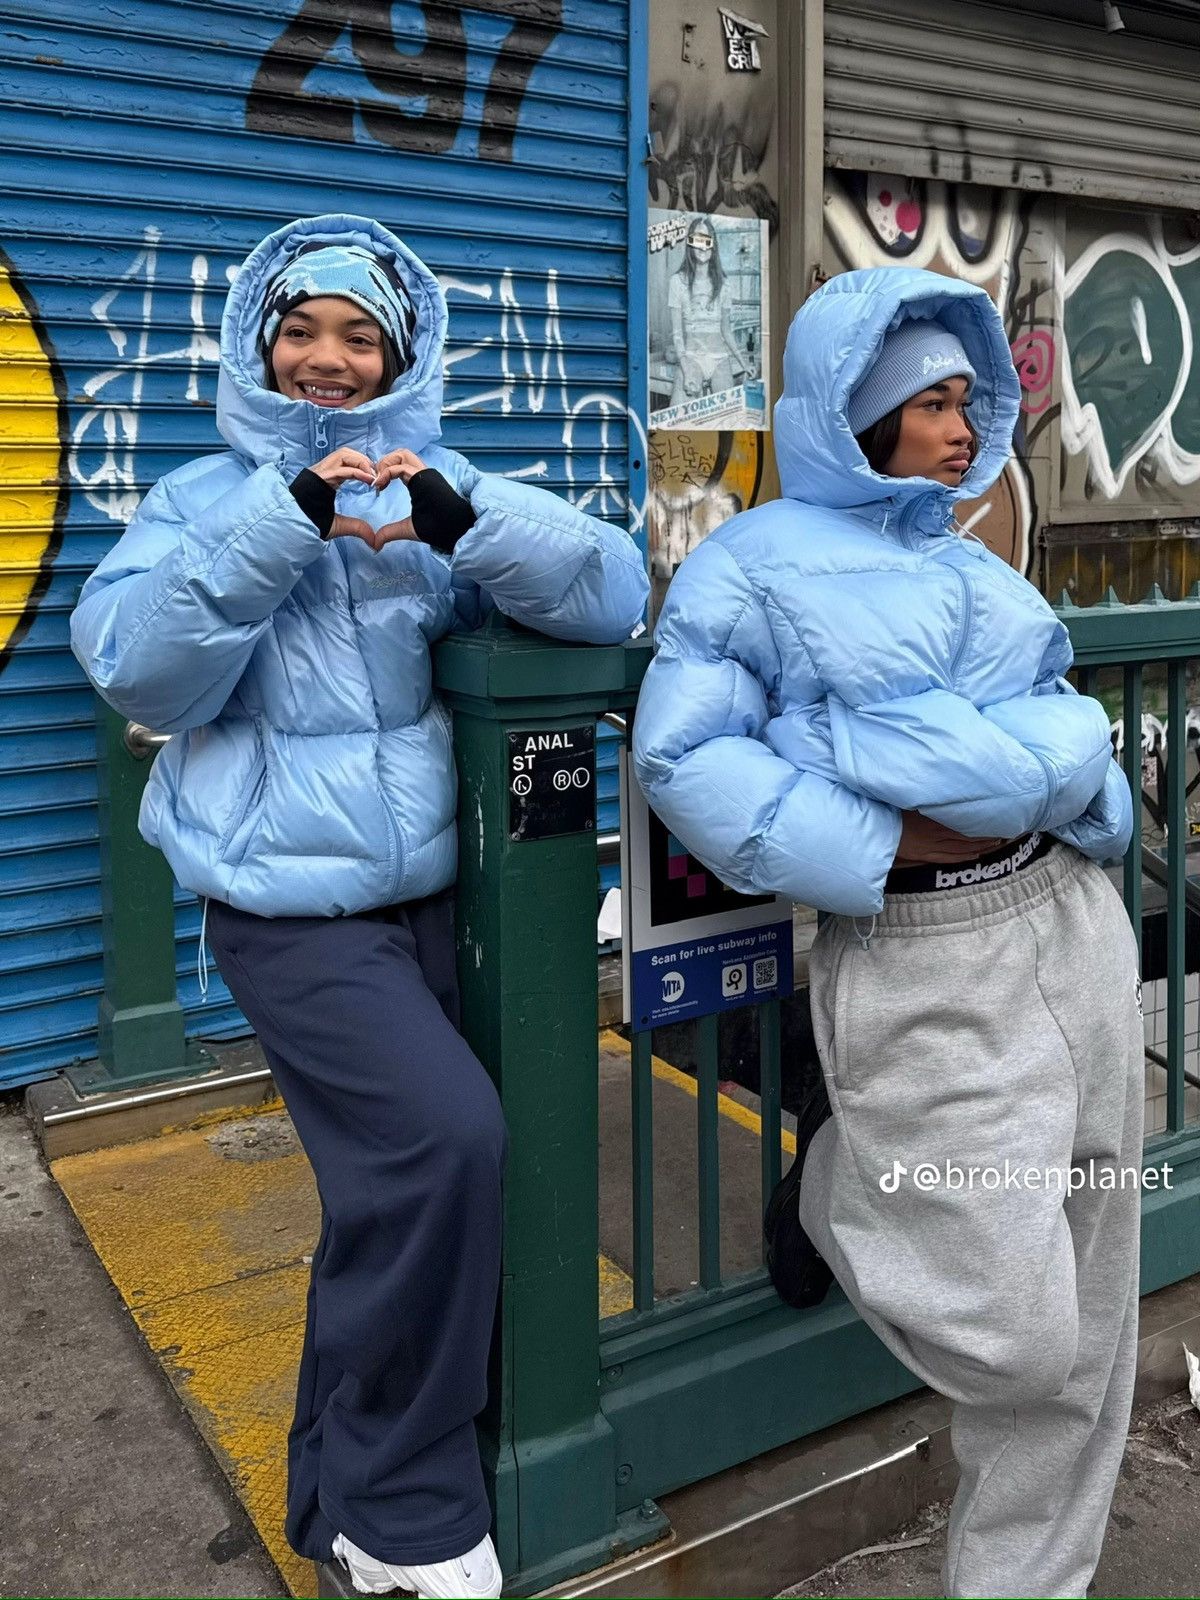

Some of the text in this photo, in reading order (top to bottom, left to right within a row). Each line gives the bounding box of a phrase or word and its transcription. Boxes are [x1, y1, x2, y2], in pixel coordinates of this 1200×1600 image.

[246, 0, 562, 163] 297
[650, 405, 679, 425] NEW
[682, 392, 727, 415] YORK'S
[524, 733, 574, 752] ANAL
[512, 754, 536, 771] ST
[651, 931, 777, 966] Scan for live subway info
[661, 979, 682, 998] MTA
